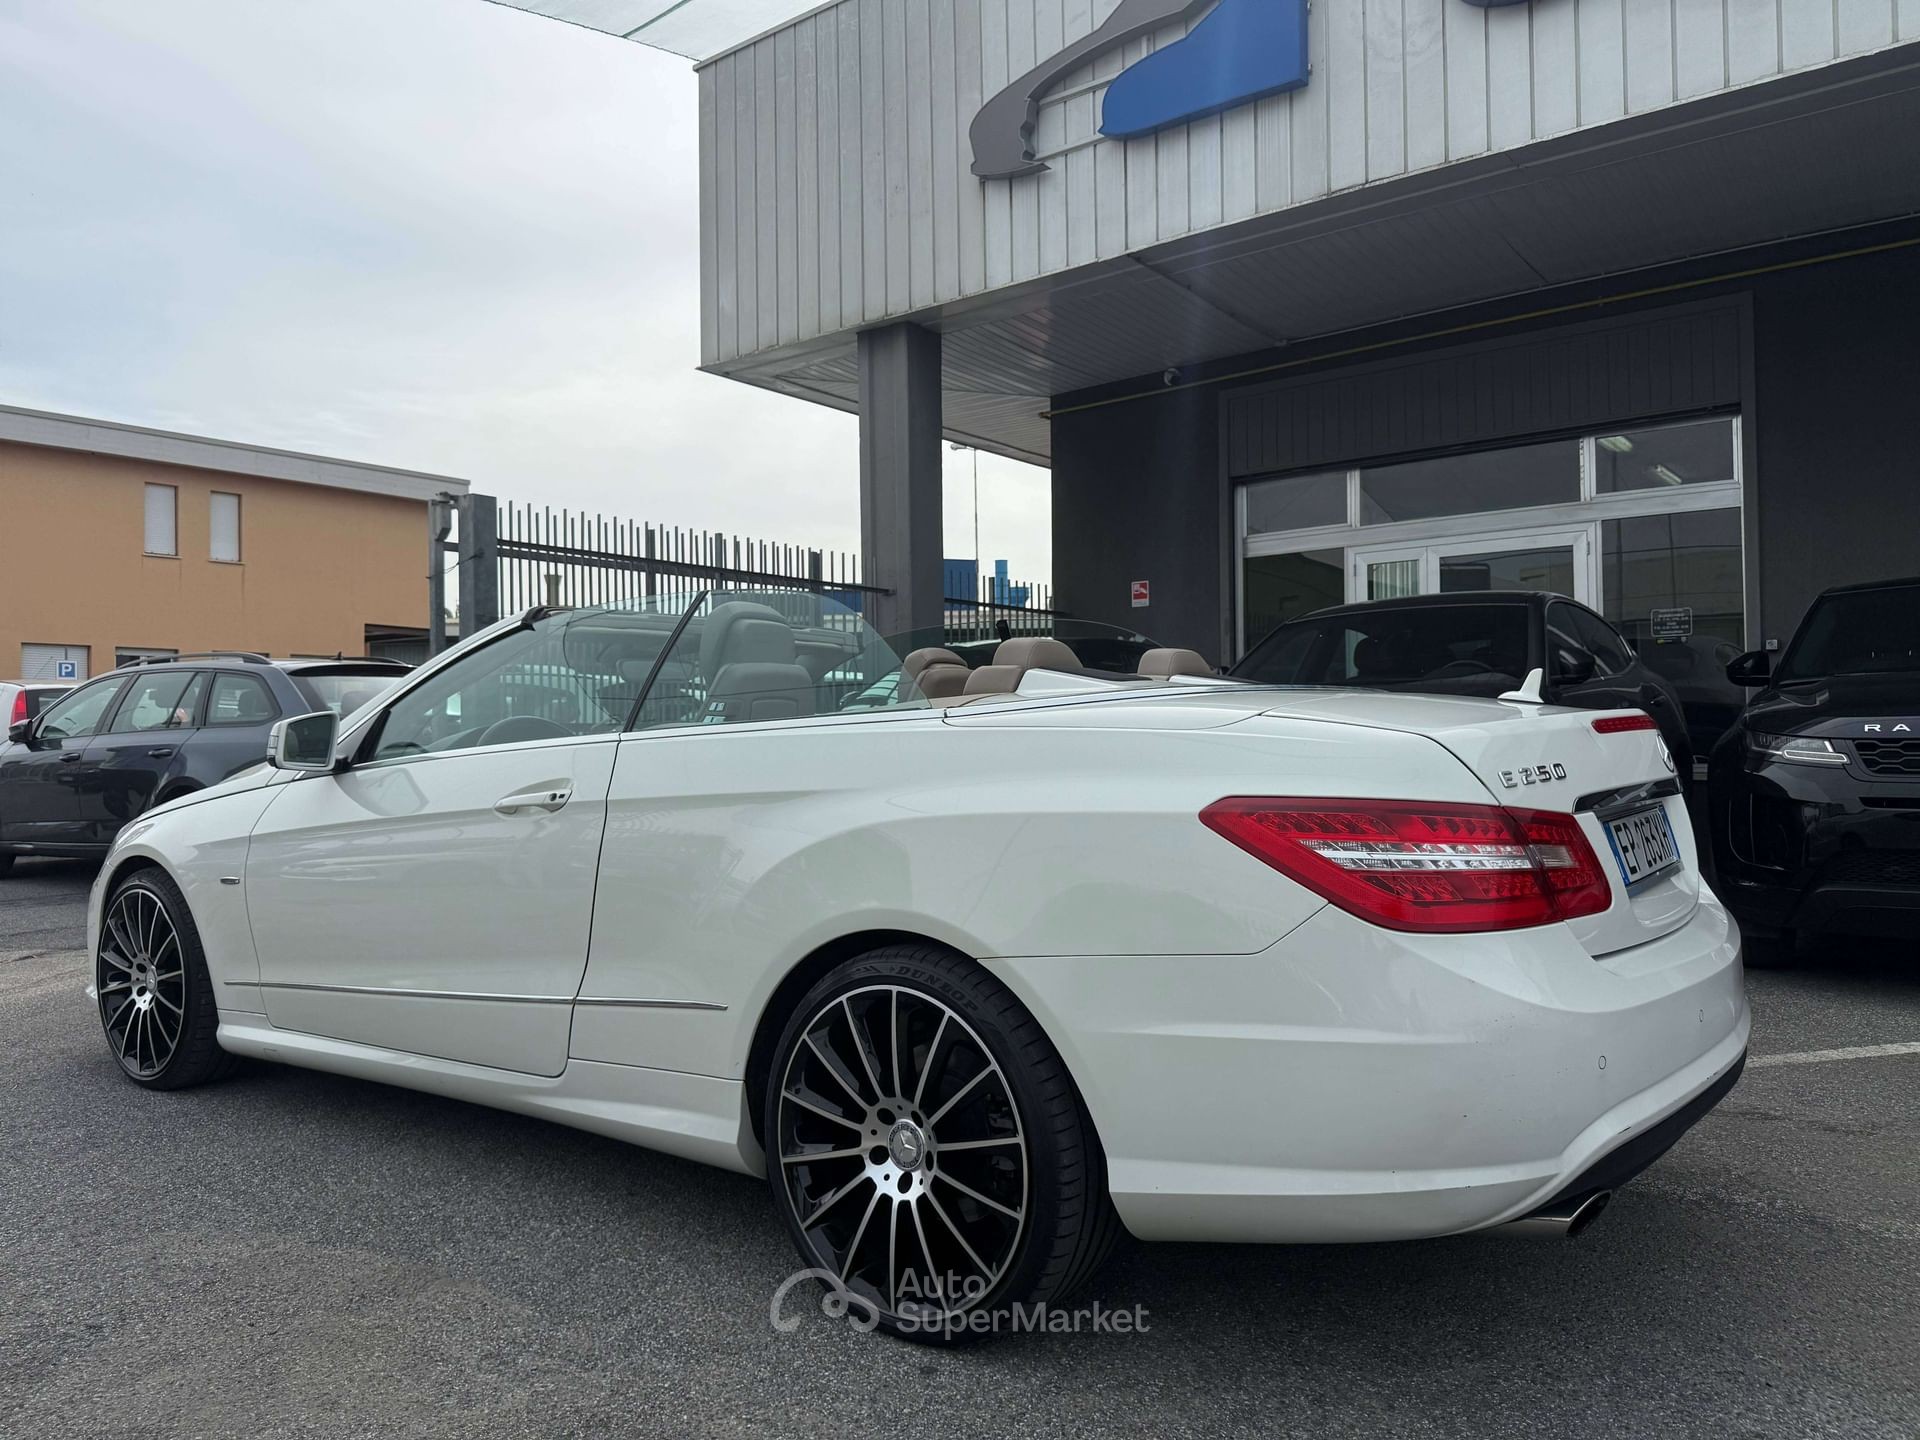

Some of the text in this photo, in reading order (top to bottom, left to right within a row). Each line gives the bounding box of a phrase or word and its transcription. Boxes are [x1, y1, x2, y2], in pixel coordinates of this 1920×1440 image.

[61, 663, 72, 676] P
[1497, 763, 1567, 788] E 250
[1614, 823, 1640, 874] EP
[895, 966, 978, 1011] DUNLOP
